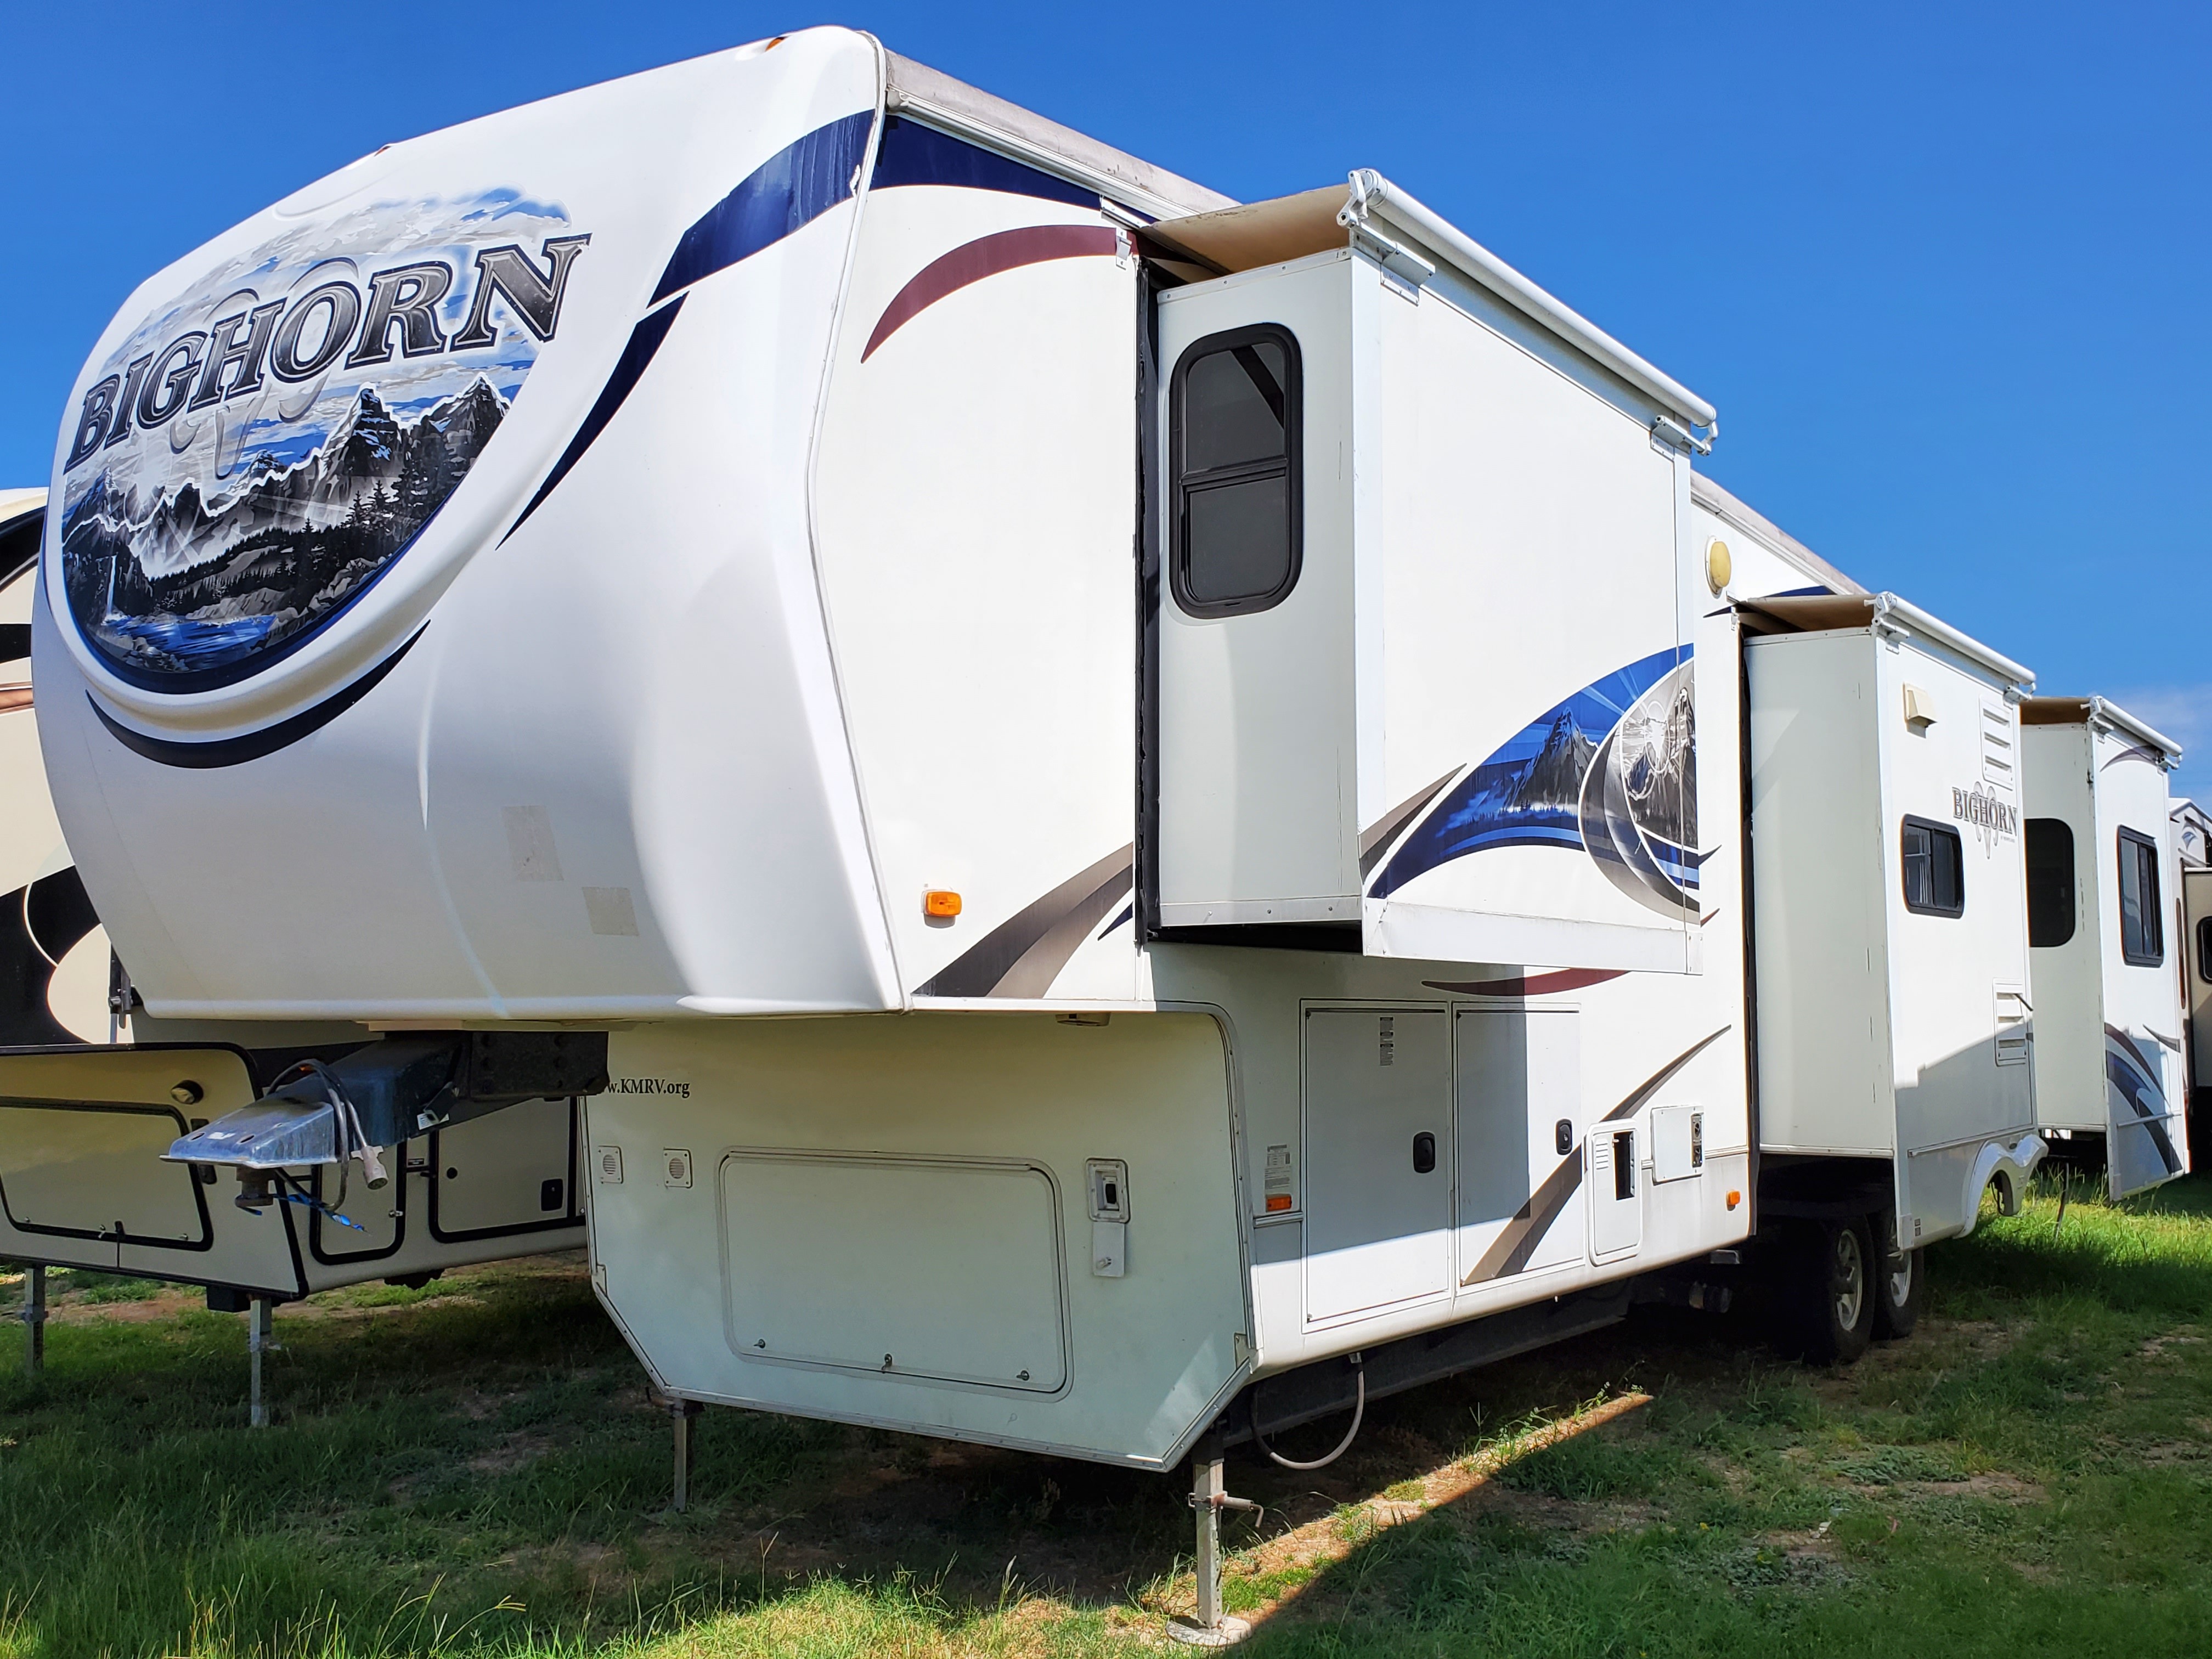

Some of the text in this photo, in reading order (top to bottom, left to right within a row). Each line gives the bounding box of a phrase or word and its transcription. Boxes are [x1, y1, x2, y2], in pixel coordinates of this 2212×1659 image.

[64, 232, 592, 475] BIGHORN
[1951, 786, 2017, 837] BIGHORN
[607, 1078, 690, 1098] w.KMRV.org
